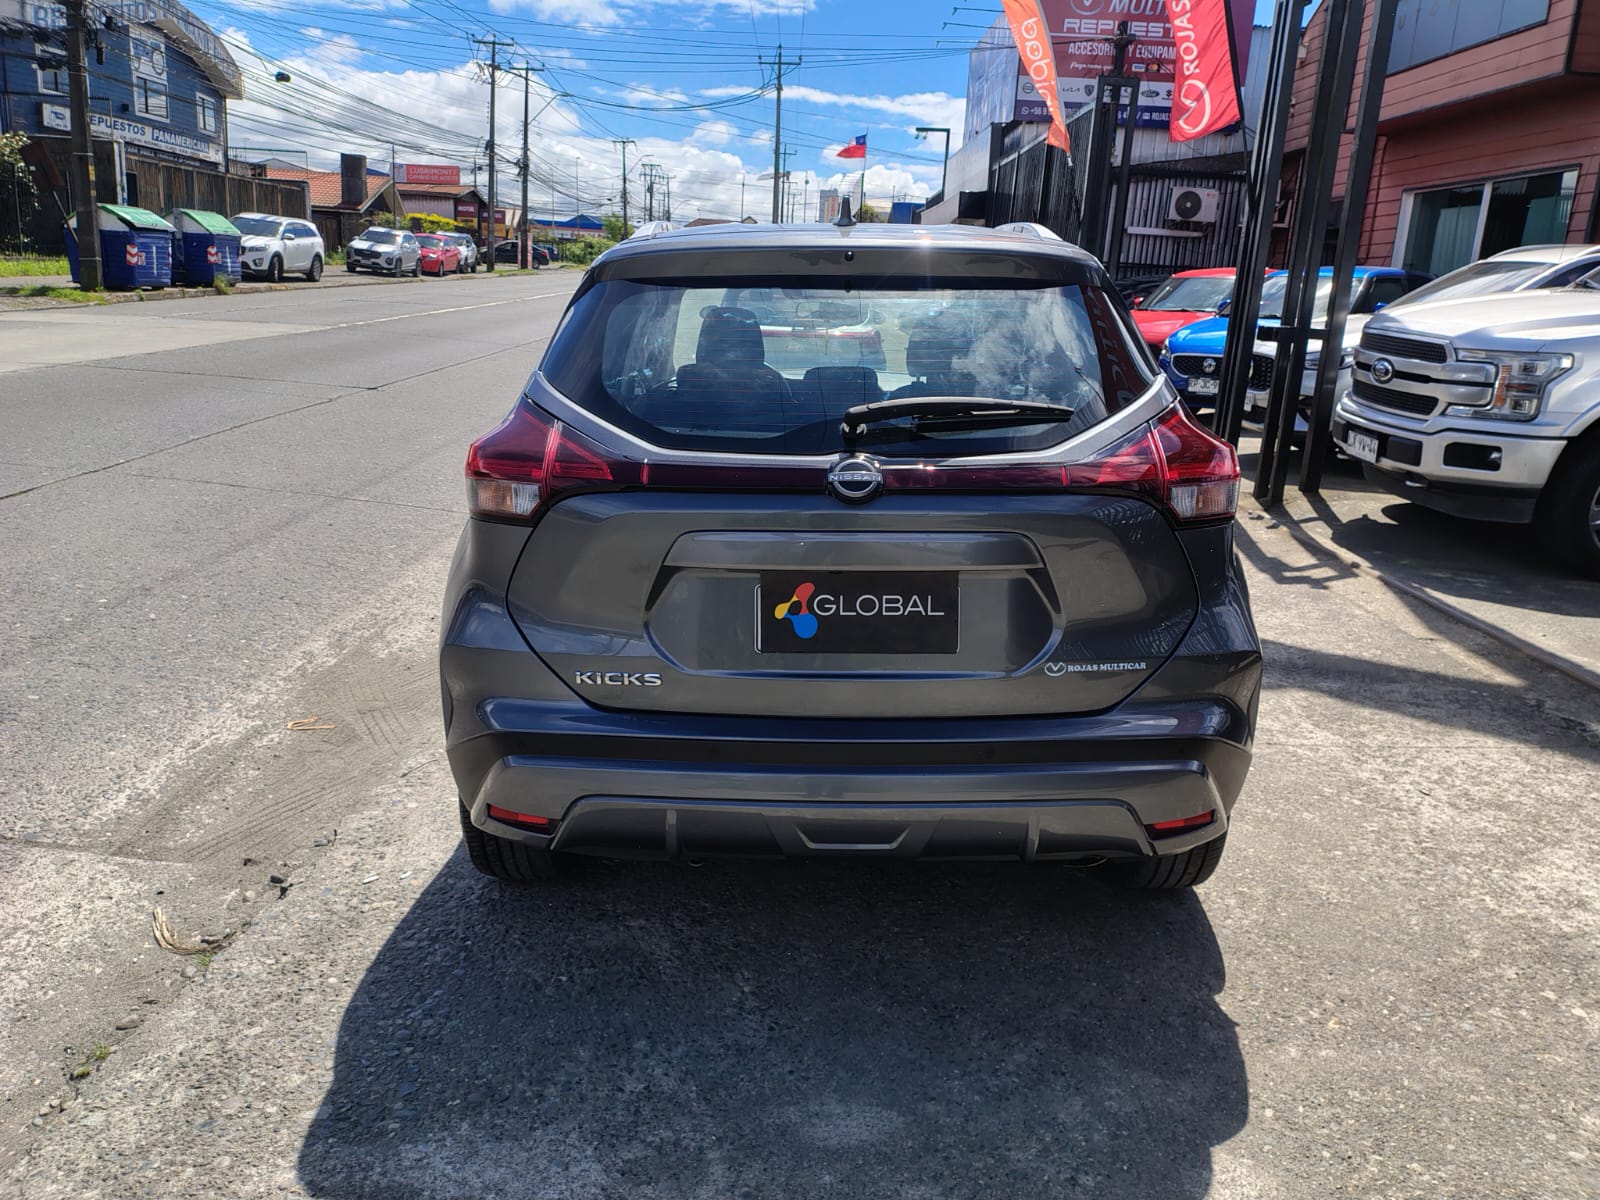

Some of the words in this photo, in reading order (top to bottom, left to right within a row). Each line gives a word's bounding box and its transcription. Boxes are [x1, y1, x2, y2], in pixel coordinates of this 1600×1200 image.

[1172, 0, 1200, 76] ROJAS
[1068, 42, 1116, 56] ACCESORI
[1128, 45, 1135, 56] Y
[88, 115, 146, 136] EPUESTOS
[153, 129, 209, 153] PANAMERICANA
[829, 473, 881, 481] NISSAN
[813, 594, 945, 616] GLOBAL
[1068, 664, 1098, 672] ROJAS
[1100, 662, 1146, 671] MULTICAR
[575, 671, 662, 686] KICKS
